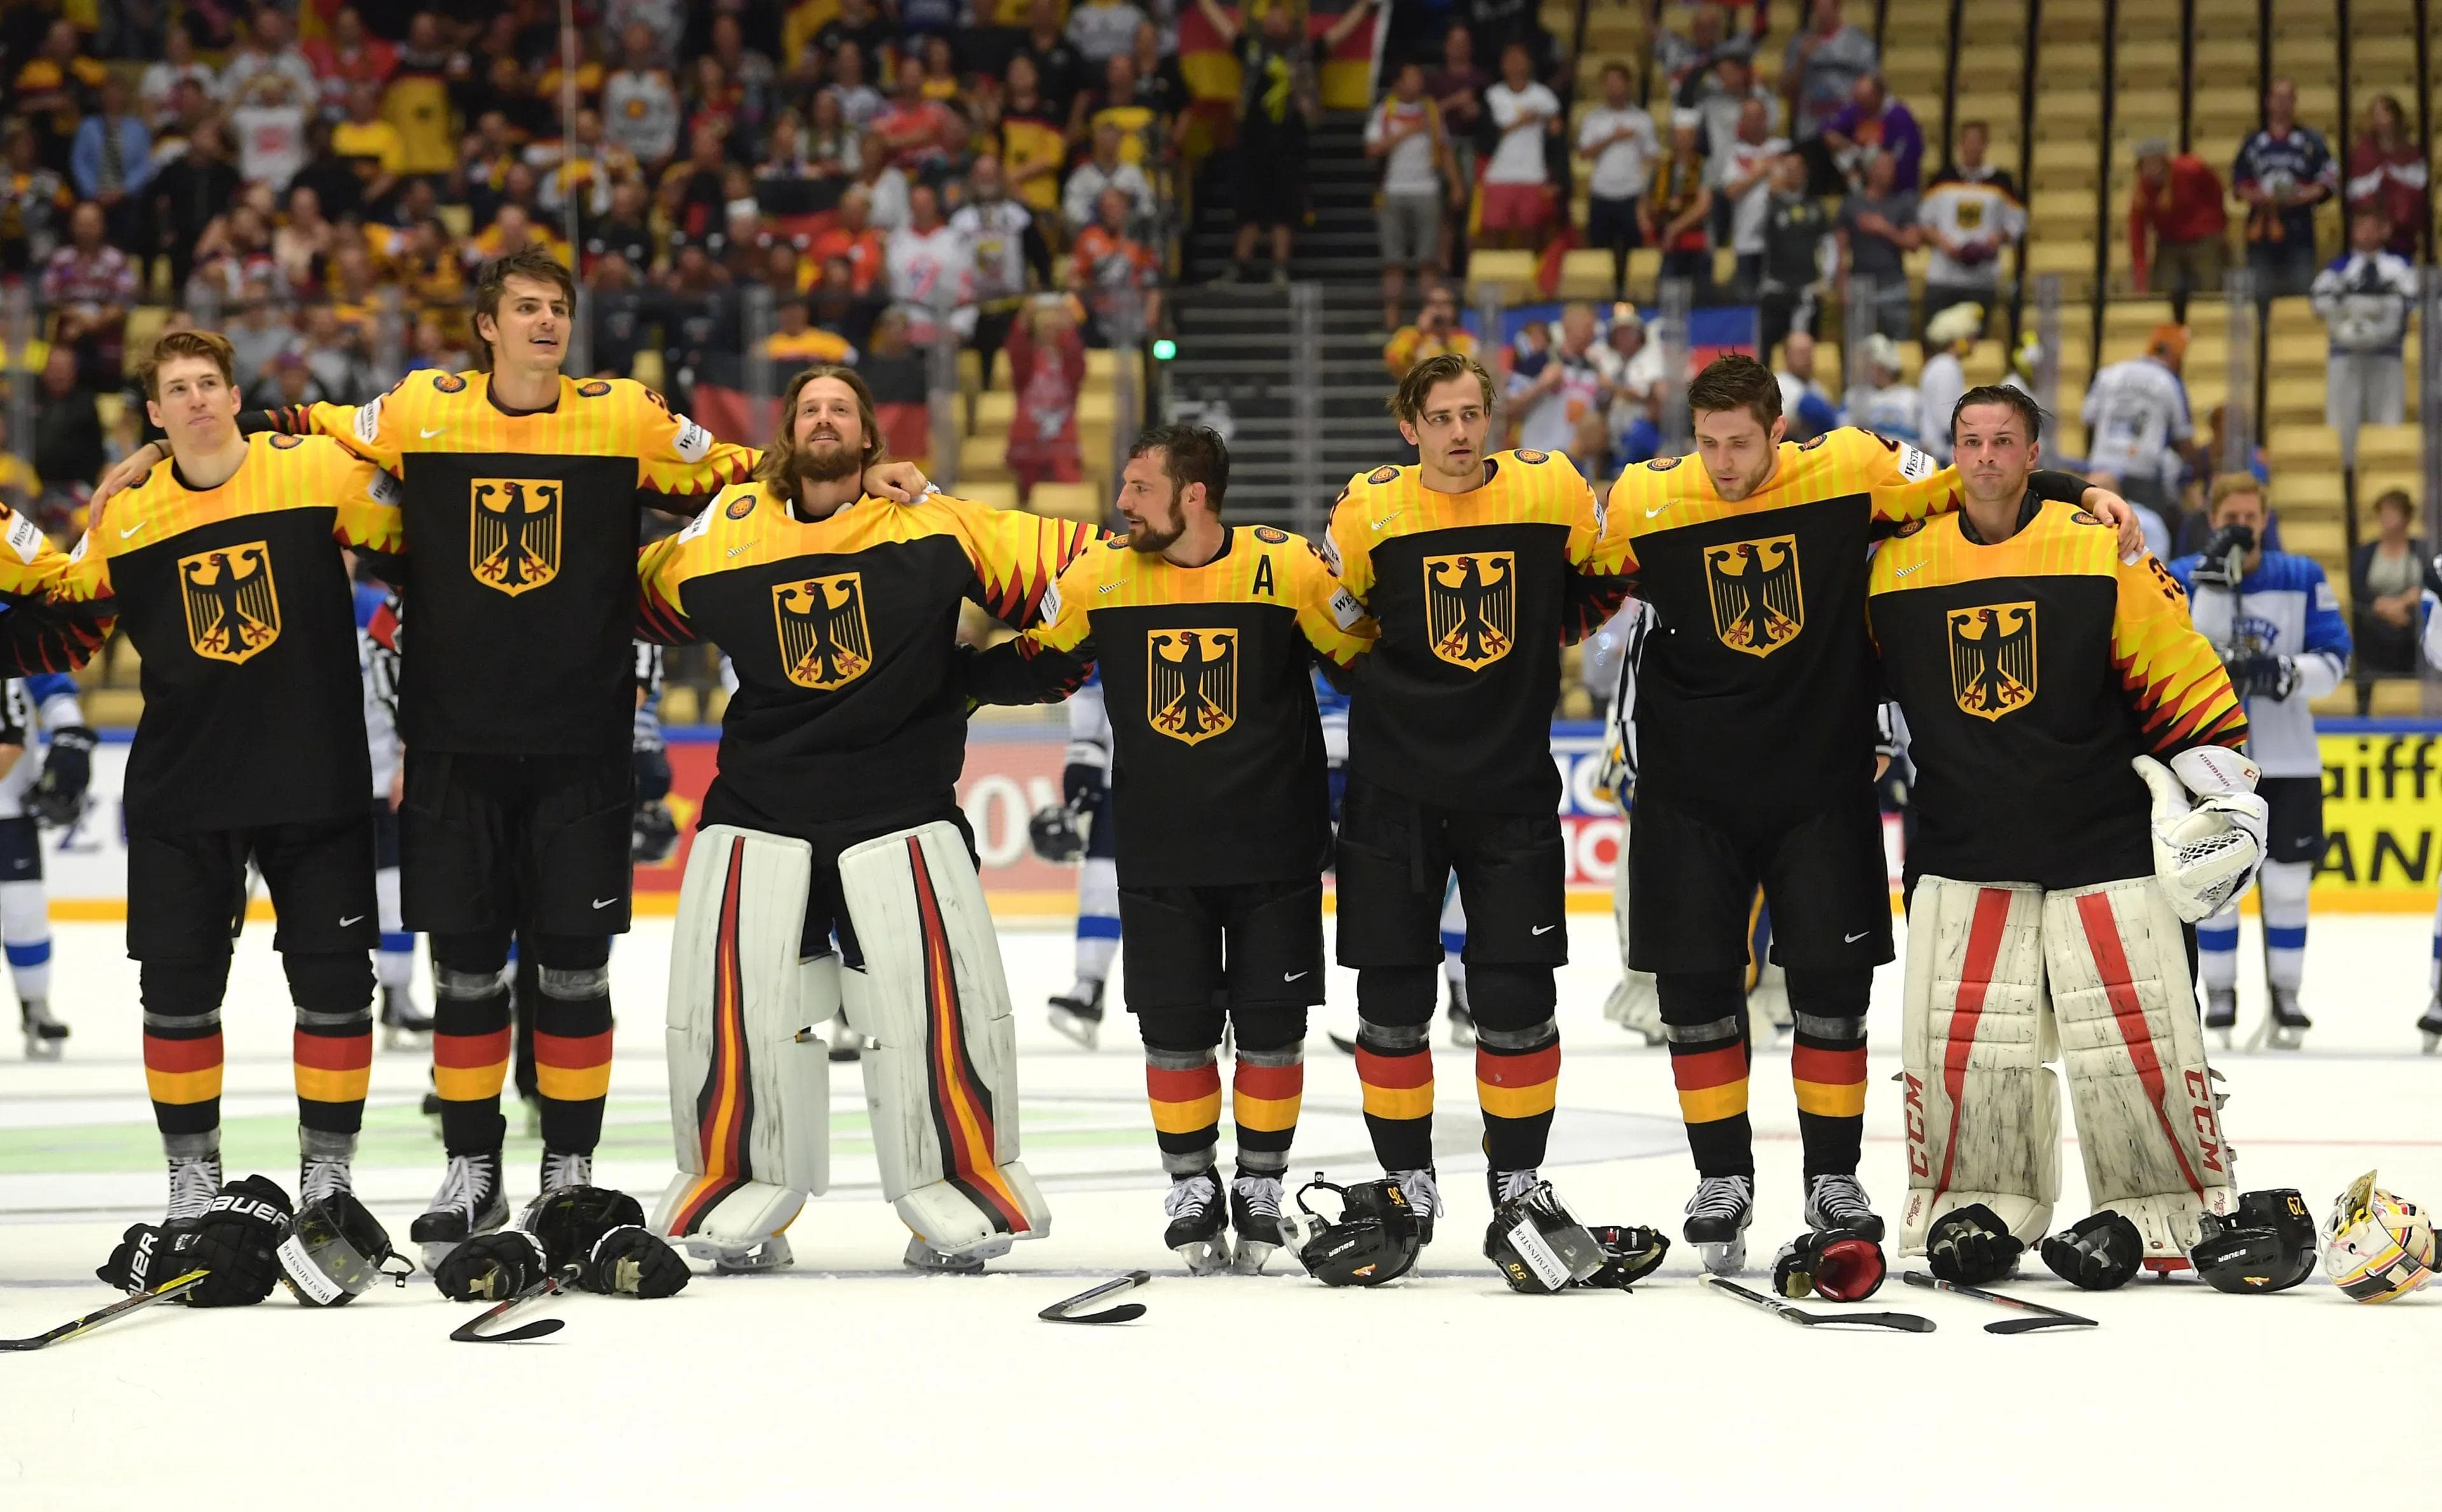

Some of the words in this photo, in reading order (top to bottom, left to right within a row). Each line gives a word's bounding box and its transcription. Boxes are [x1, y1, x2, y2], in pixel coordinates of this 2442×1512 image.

[1252, 554, 1274, 596] A
[1905, 1071, 1929, 1178] CCM
[2184, 1069, 2222, 1172] CCM
[1328, 1240, 1355, 1257] BAUER
[1515, 1228, 1561, 1286] WESTMINSTER
[2218, 1248, 2246, 1263] BAUER
[1510, 1263, 1526, 1279] 58
